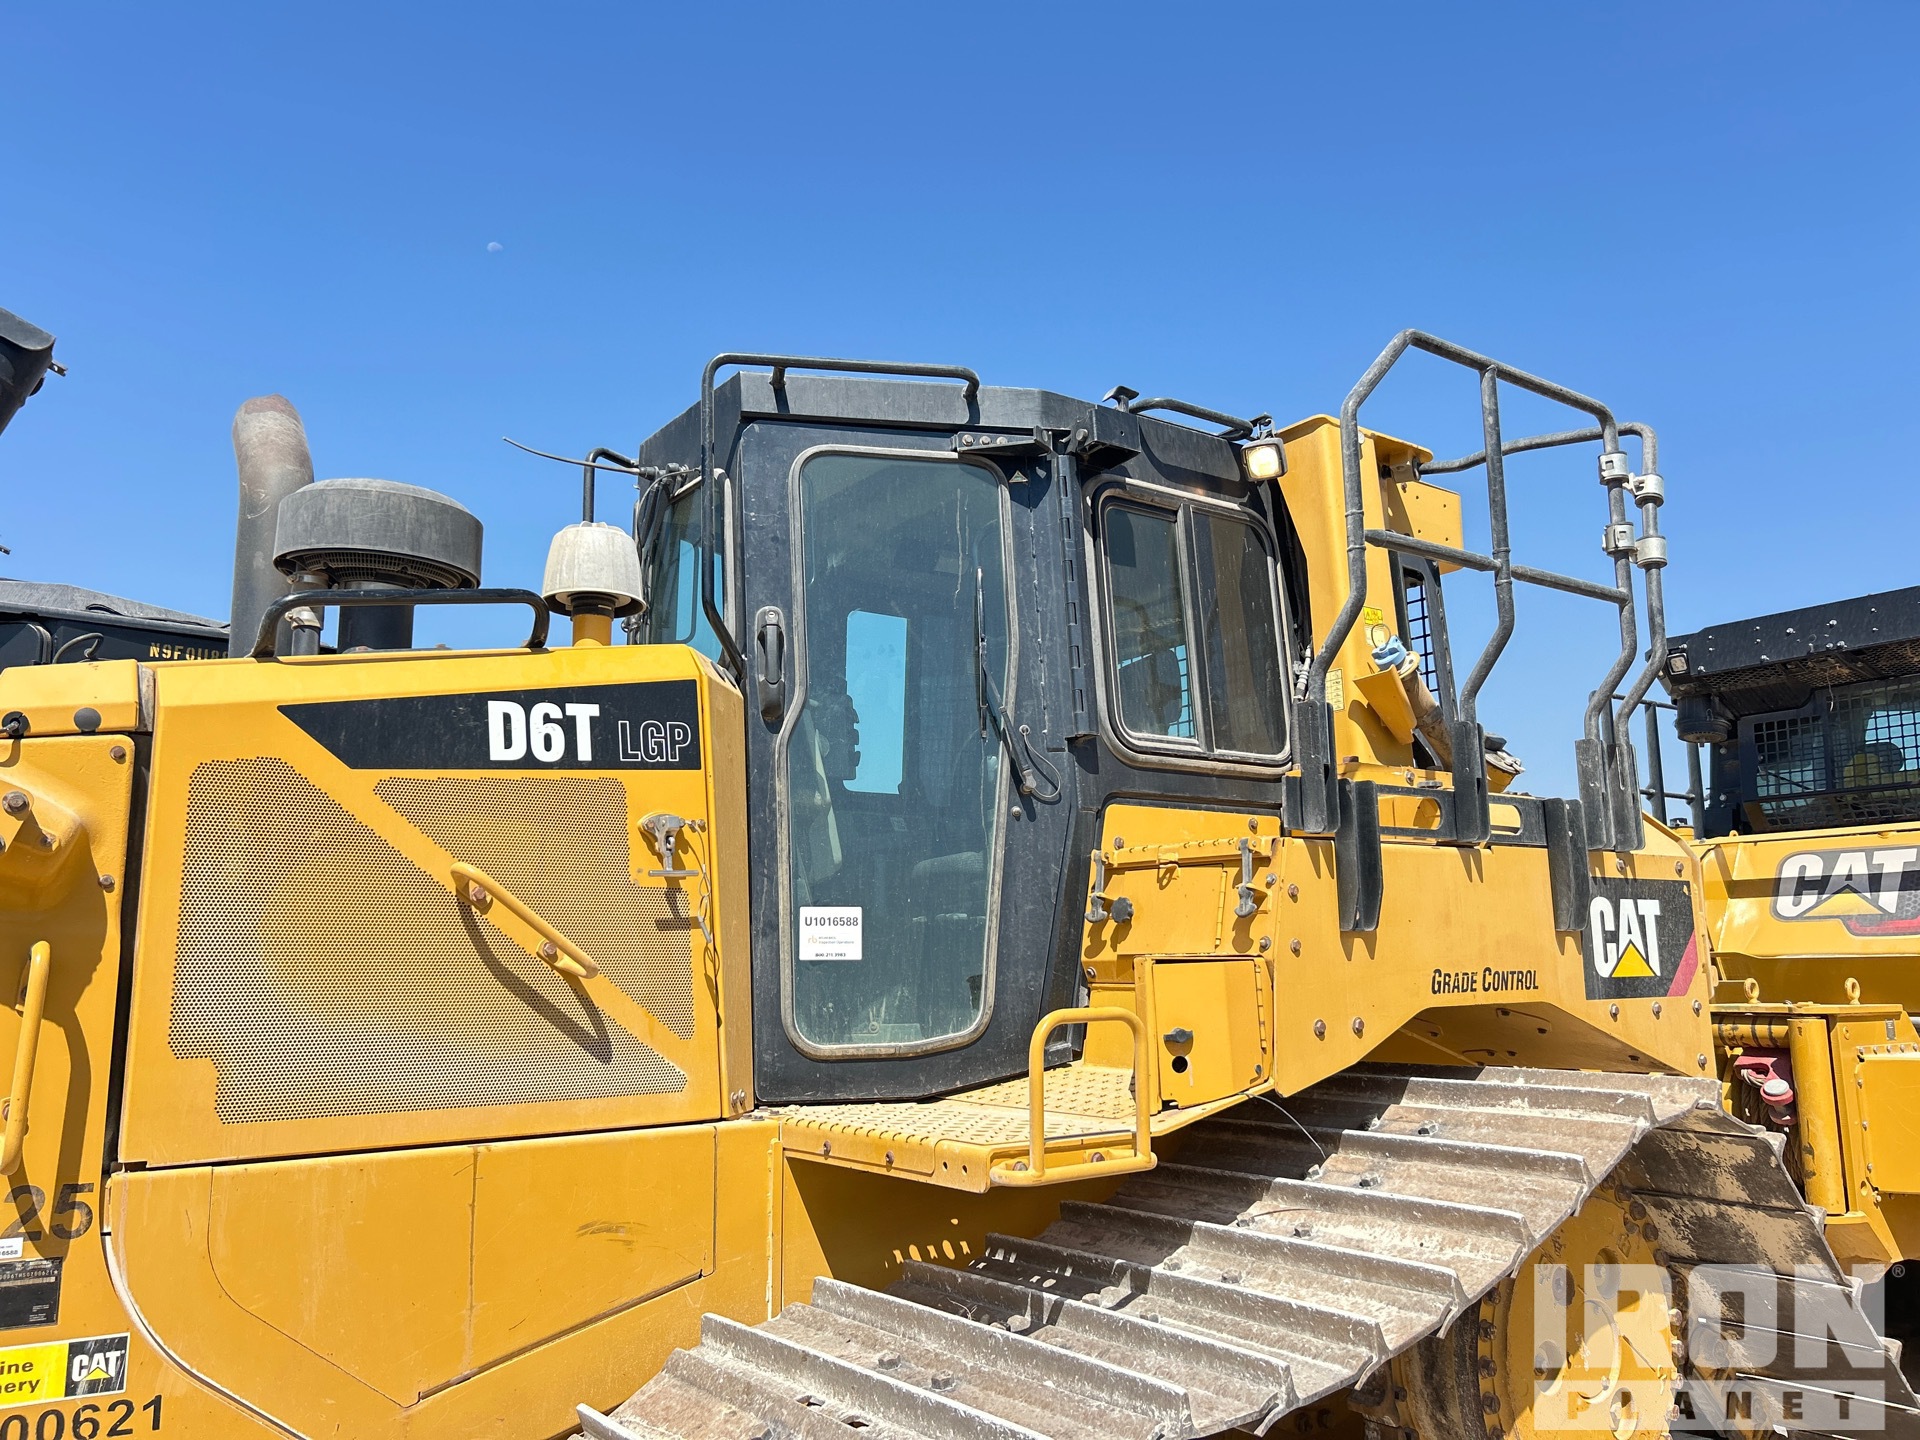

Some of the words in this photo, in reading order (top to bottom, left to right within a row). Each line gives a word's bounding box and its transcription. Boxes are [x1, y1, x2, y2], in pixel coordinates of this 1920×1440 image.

[487, 700, 600, 763] D6T
[617, 720, 691, 763] LGP
[1776, 848, 1918, 918] CAT
[804, 916, 859, 927] U1016588
[1590, 896, 1661, 978] CAT
[1431, 968, 1478, 995] GRADE
[1482, 966, 1539, 992] CONTROL
[72, 1351, 121, 1382] CAT
[0, 1395, 162, 1440] 00621
